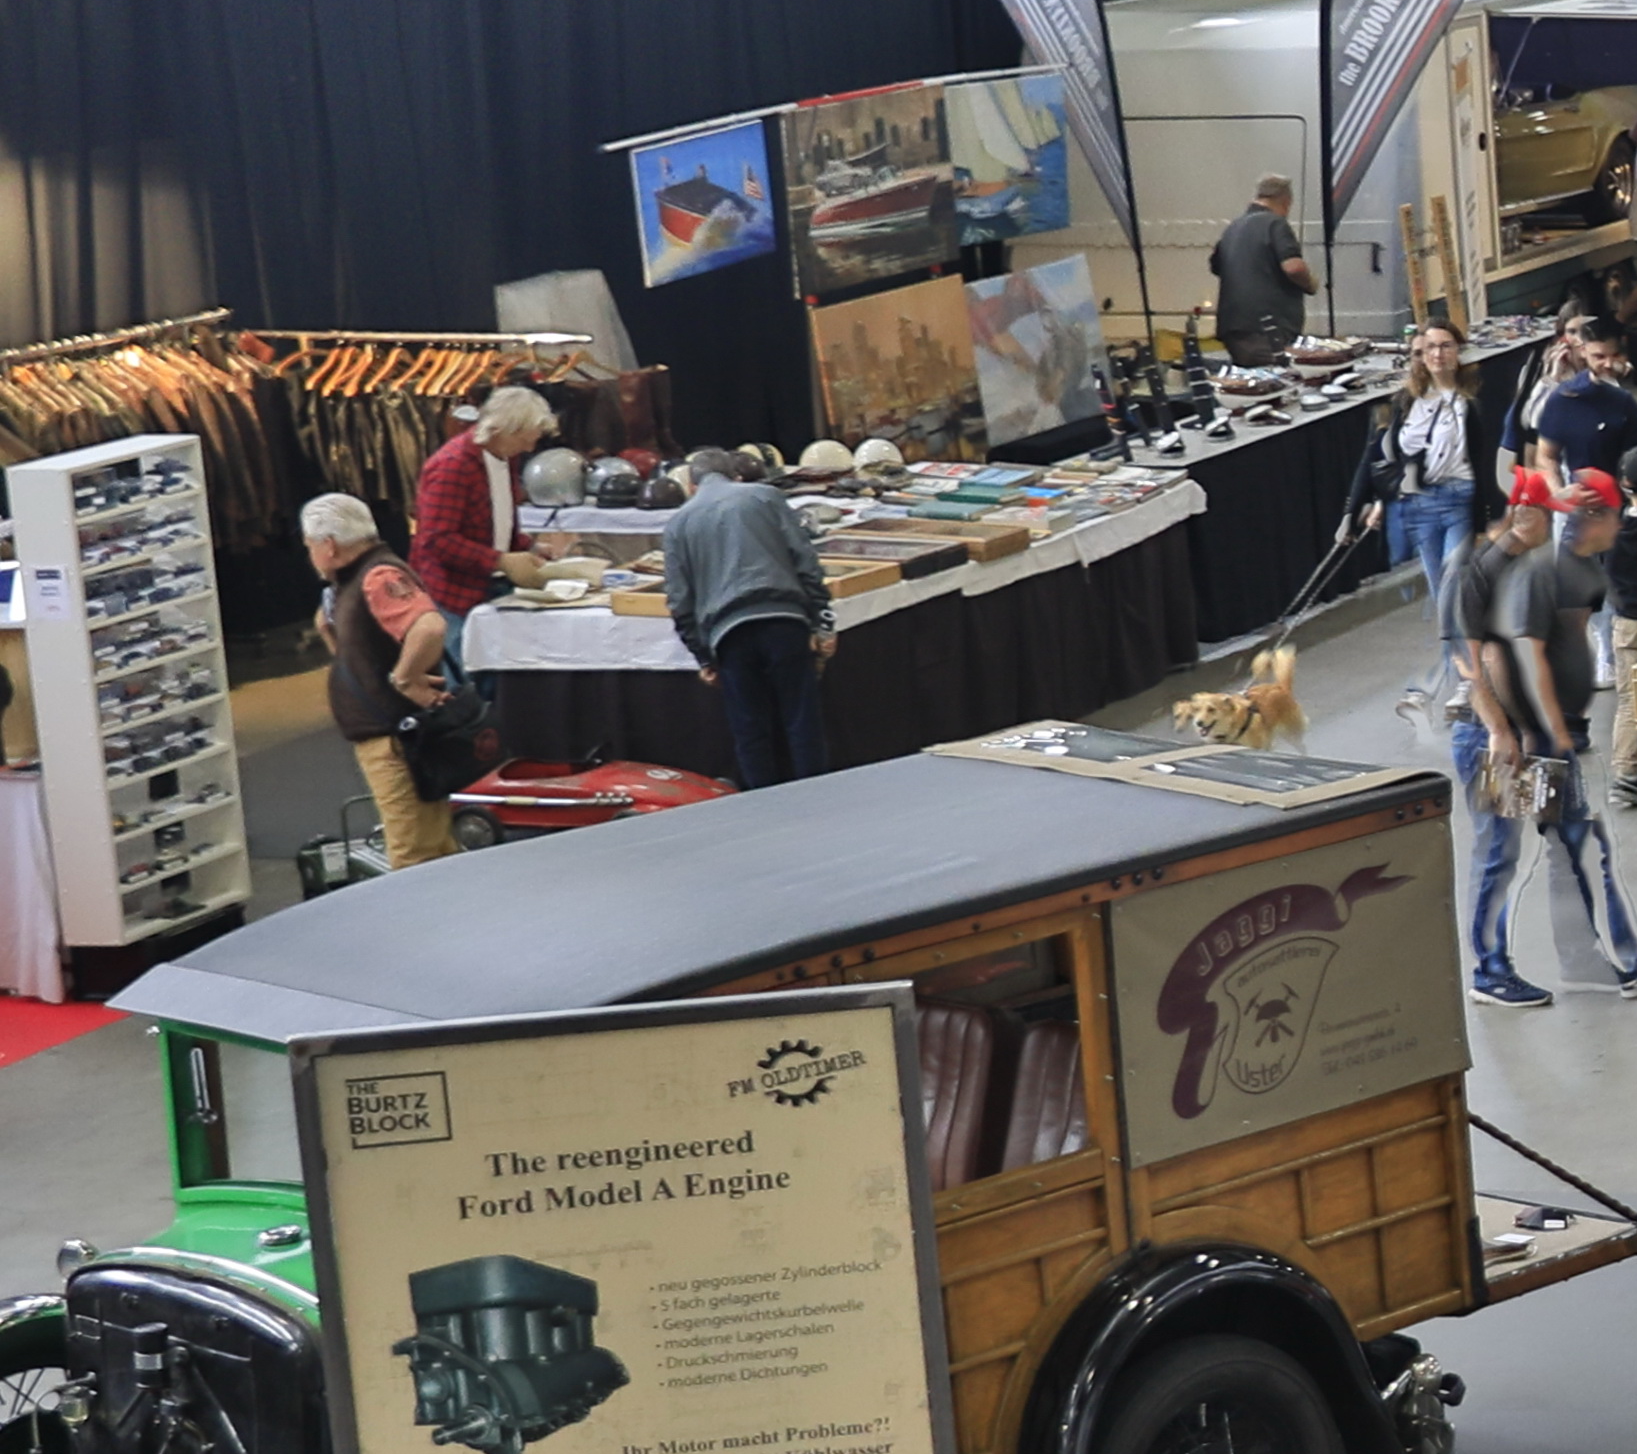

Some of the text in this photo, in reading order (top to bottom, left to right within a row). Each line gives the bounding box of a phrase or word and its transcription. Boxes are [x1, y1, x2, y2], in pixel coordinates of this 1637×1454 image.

[1338, 55, 1363, 87] the
[726, 1048, 868, 1099] FM OLDTIMER
[1235, 1054, 1287, 1089] Uster
[346, 1081, 379, 1097] THE
[346, 1092, 429, 1117] BURTZ
[348, 1112, 431, 1136] BLOCK
[484, 1130, 755, 1179] The reengineered
[457, 1168, 791, 1221] Ford Model A Engine
[658, 1259, 883, 1293] neu gegossener Zylinderblock
[661, 1299, 865, 1331] Gegengewichtskurbelwelle
[673, 1289, 781, 1311] fach gelagerte
[664, 1322, 835, 1350] moderne Lagerschalen
[666, 1344, 799, 1371] Druckschmierung
[667, 1361, 828, 1389] moderne Dichtungen
[722, 1429, 780, 1450] macht
[785, 1416, 892, 1444] Probleme?!
